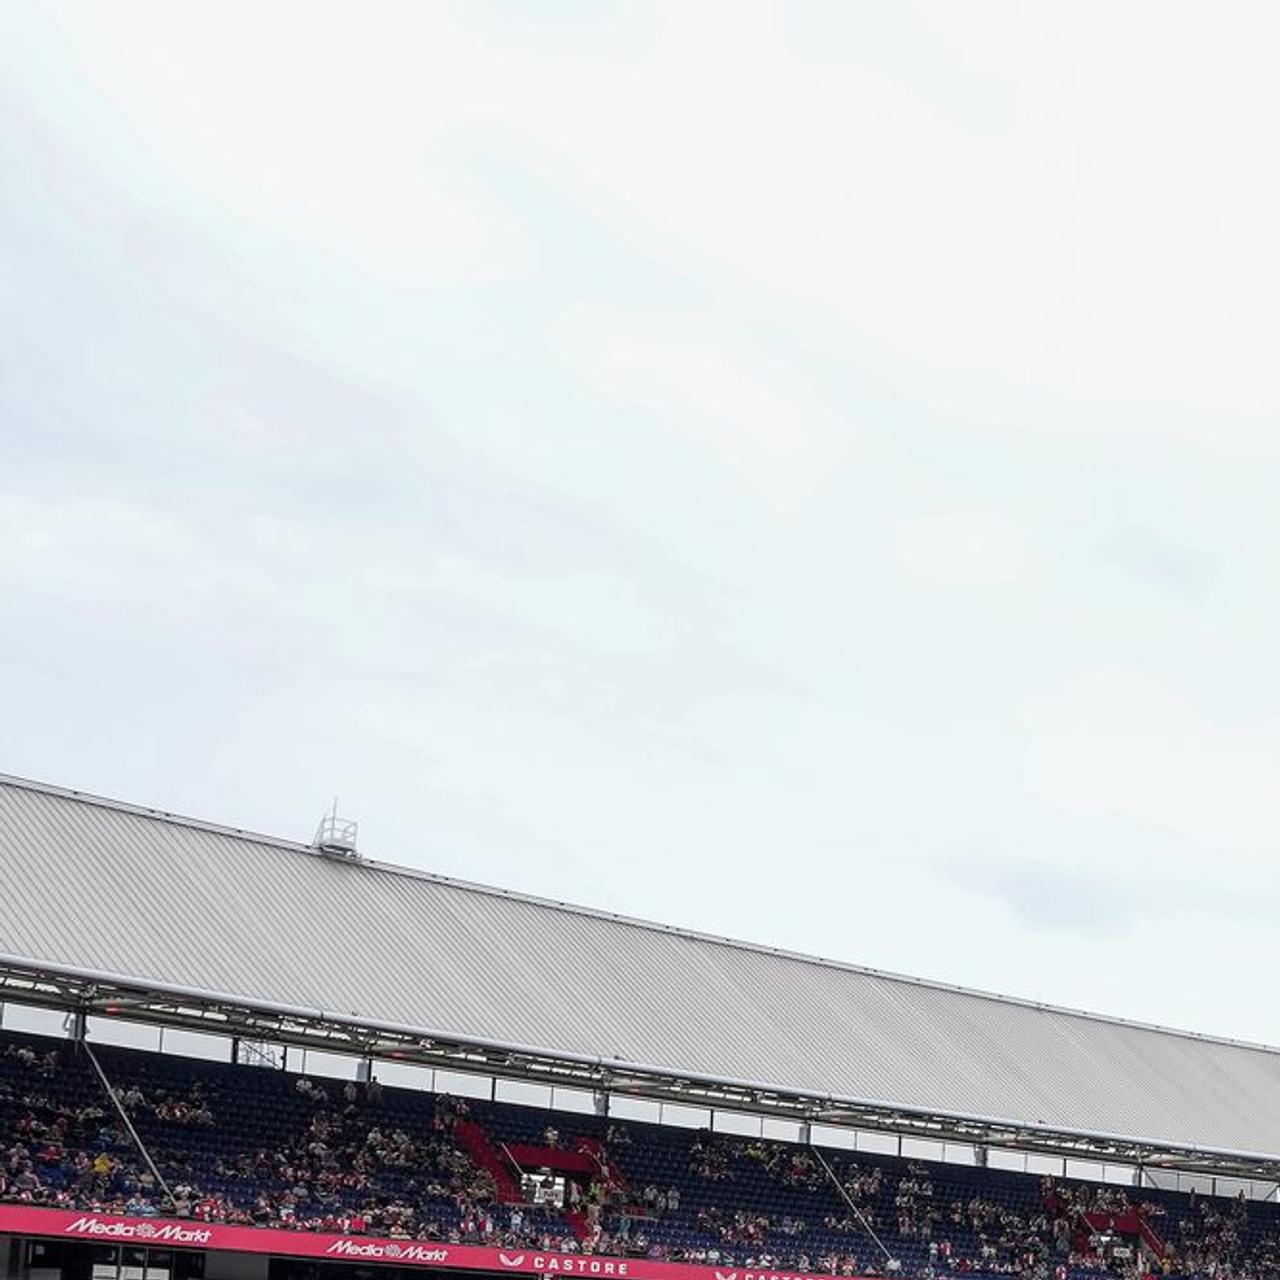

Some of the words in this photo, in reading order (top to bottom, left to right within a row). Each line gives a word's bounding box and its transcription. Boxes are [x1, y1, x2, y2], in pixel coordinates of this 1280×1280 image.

[65, 1217, 135, 1237] Media
[152, 1224, 212, 1243] Markt
[327, 1240, 383, 1257] Media
[400, 1246, 448, 1262] Markt
[533, 1257, 628, 1275] CASTORE
